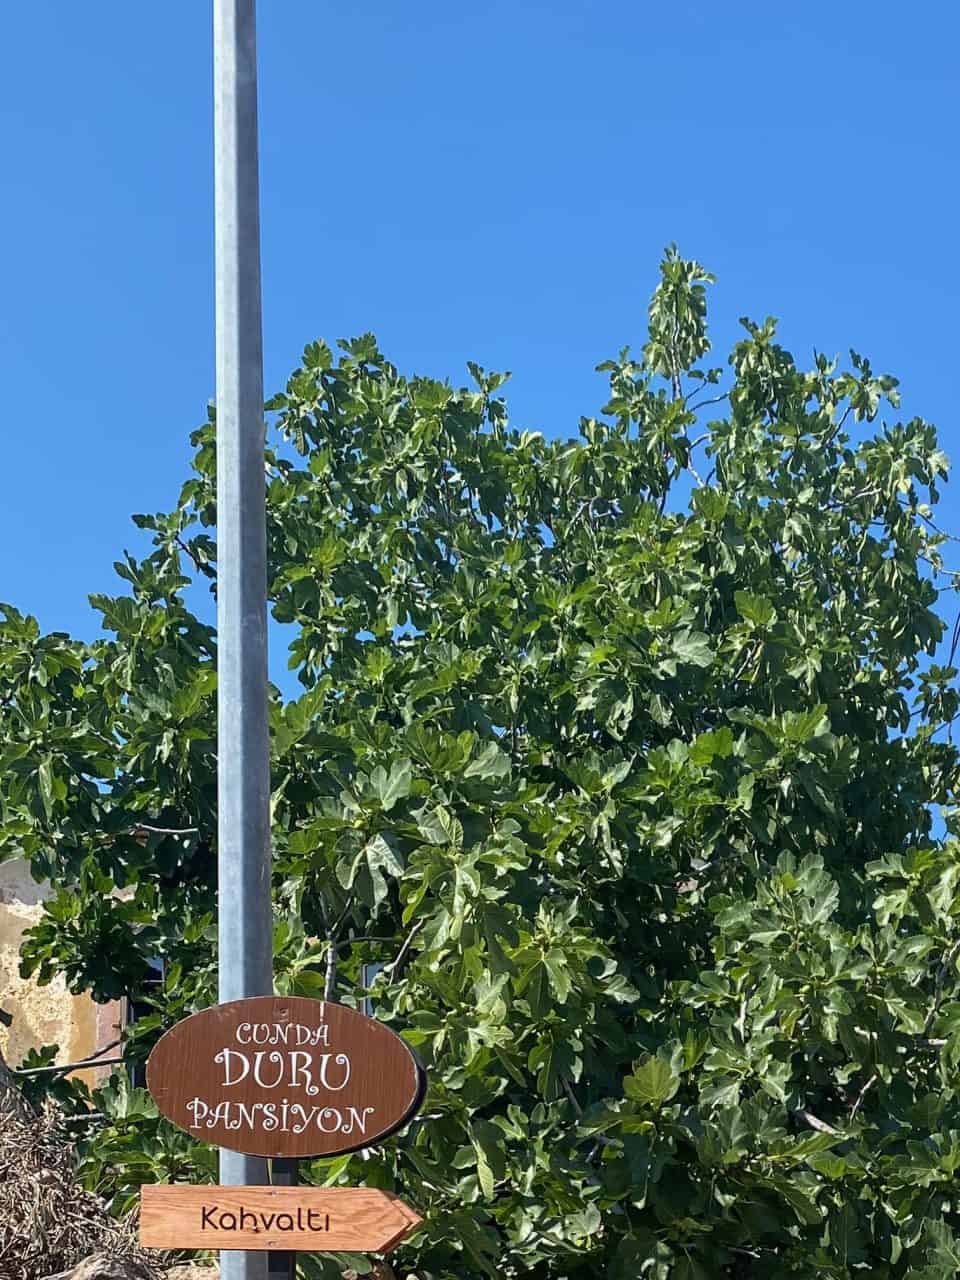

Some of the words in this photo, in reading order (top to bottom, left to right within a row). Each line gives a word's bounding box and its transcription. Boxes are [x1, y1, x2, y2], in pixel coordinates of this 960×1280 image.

[236, 1022, 330, 1046] CUNDA
[214, 1048, 350, 1096] DURU
[186, 1096, 374, 1135] PANSİYON
[201, 1206, 331, 1232] Kahvaltı
